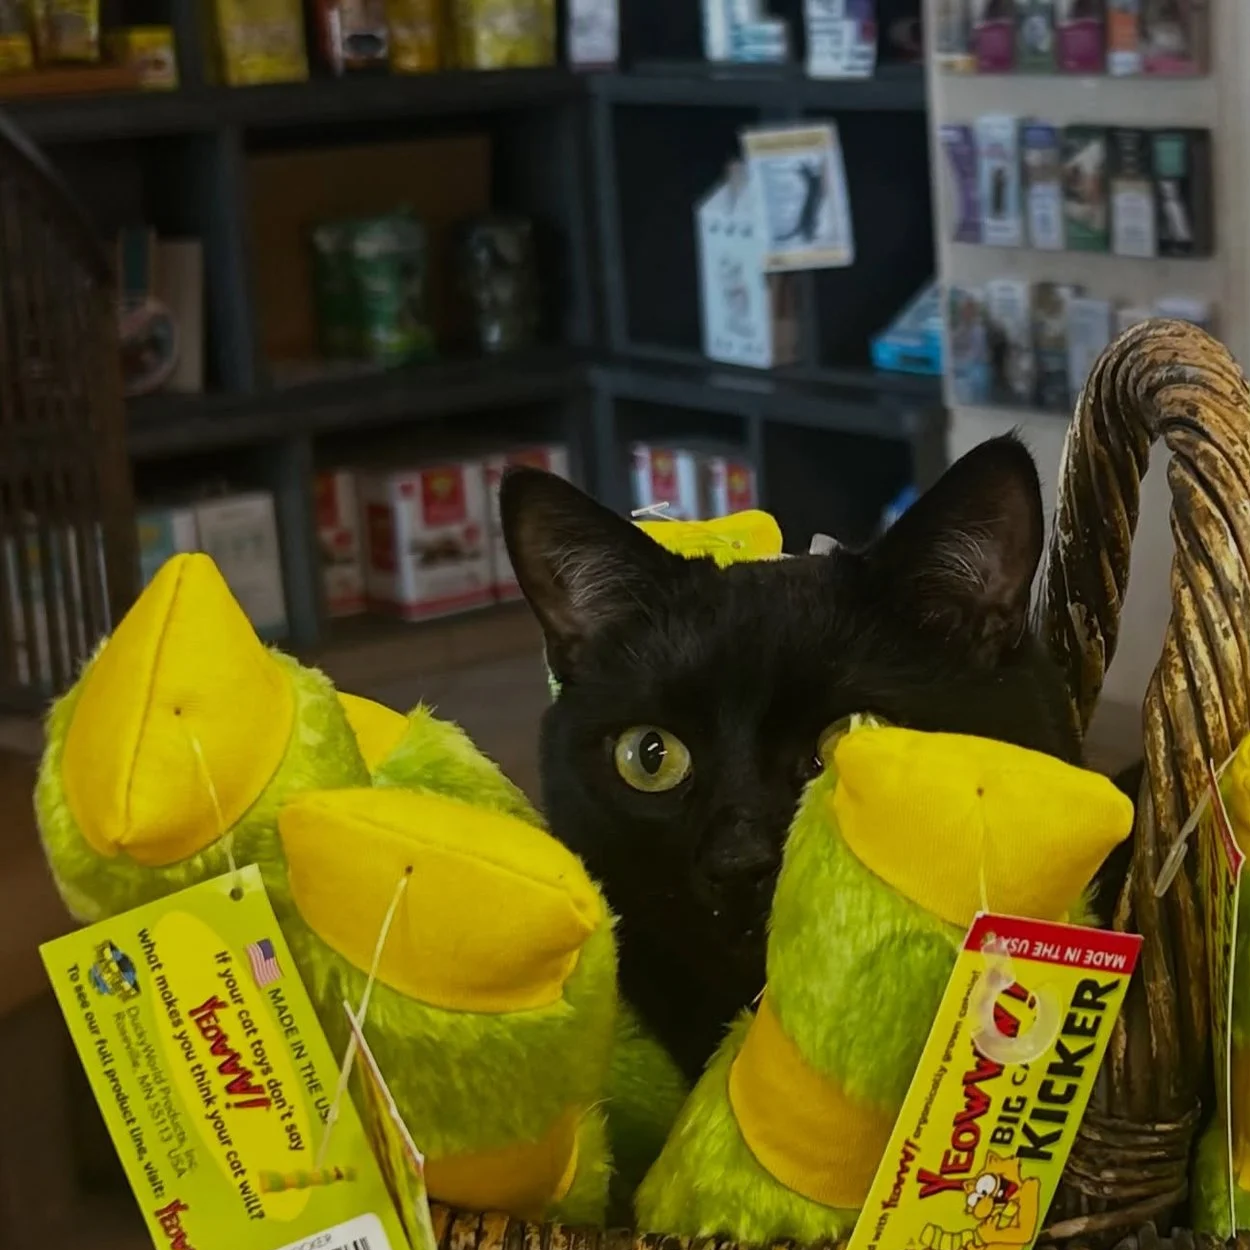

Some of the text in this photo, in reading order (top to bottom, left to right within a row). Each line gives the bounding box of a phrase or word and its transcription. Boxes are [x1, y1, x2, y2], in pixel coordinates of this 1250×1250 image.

[67, 963, 80, 982] To
[1031, 941, 1061, 961] THE
[1063, 946, 1081, 963] IN
[1083, 949, 1127, 970] MADE
[74, 984, 90, 1009] see
[84, 1011, 100, 1035] our
[268, 987, 300, 1039] MADE
[290, 1040, 308, 1061] IN
[300, 1061, 324, 1095] THE
[95, 1038, 114, 1067] full
[214, 950, 305, 1151] If your cat toys don't say
[1016, 977, 1121, 1161] KICKER
[137, 928, 265, 1221] what makes you think your cat will?
[103, 1068, 137, 1127] product
[138, 1074, 156, 1100] MN
[148, 1102, 173, 1143] 55113
[167, 1148, 187, 1179] USA
[872, 1212, 890, 1242] with
[913, 1064, 948, 1139] organically
[942, 1020, 963, 1063] grown
[989, 1096, 1027, 1145] BIG
[143, 1161, 165, 1198] visit:
